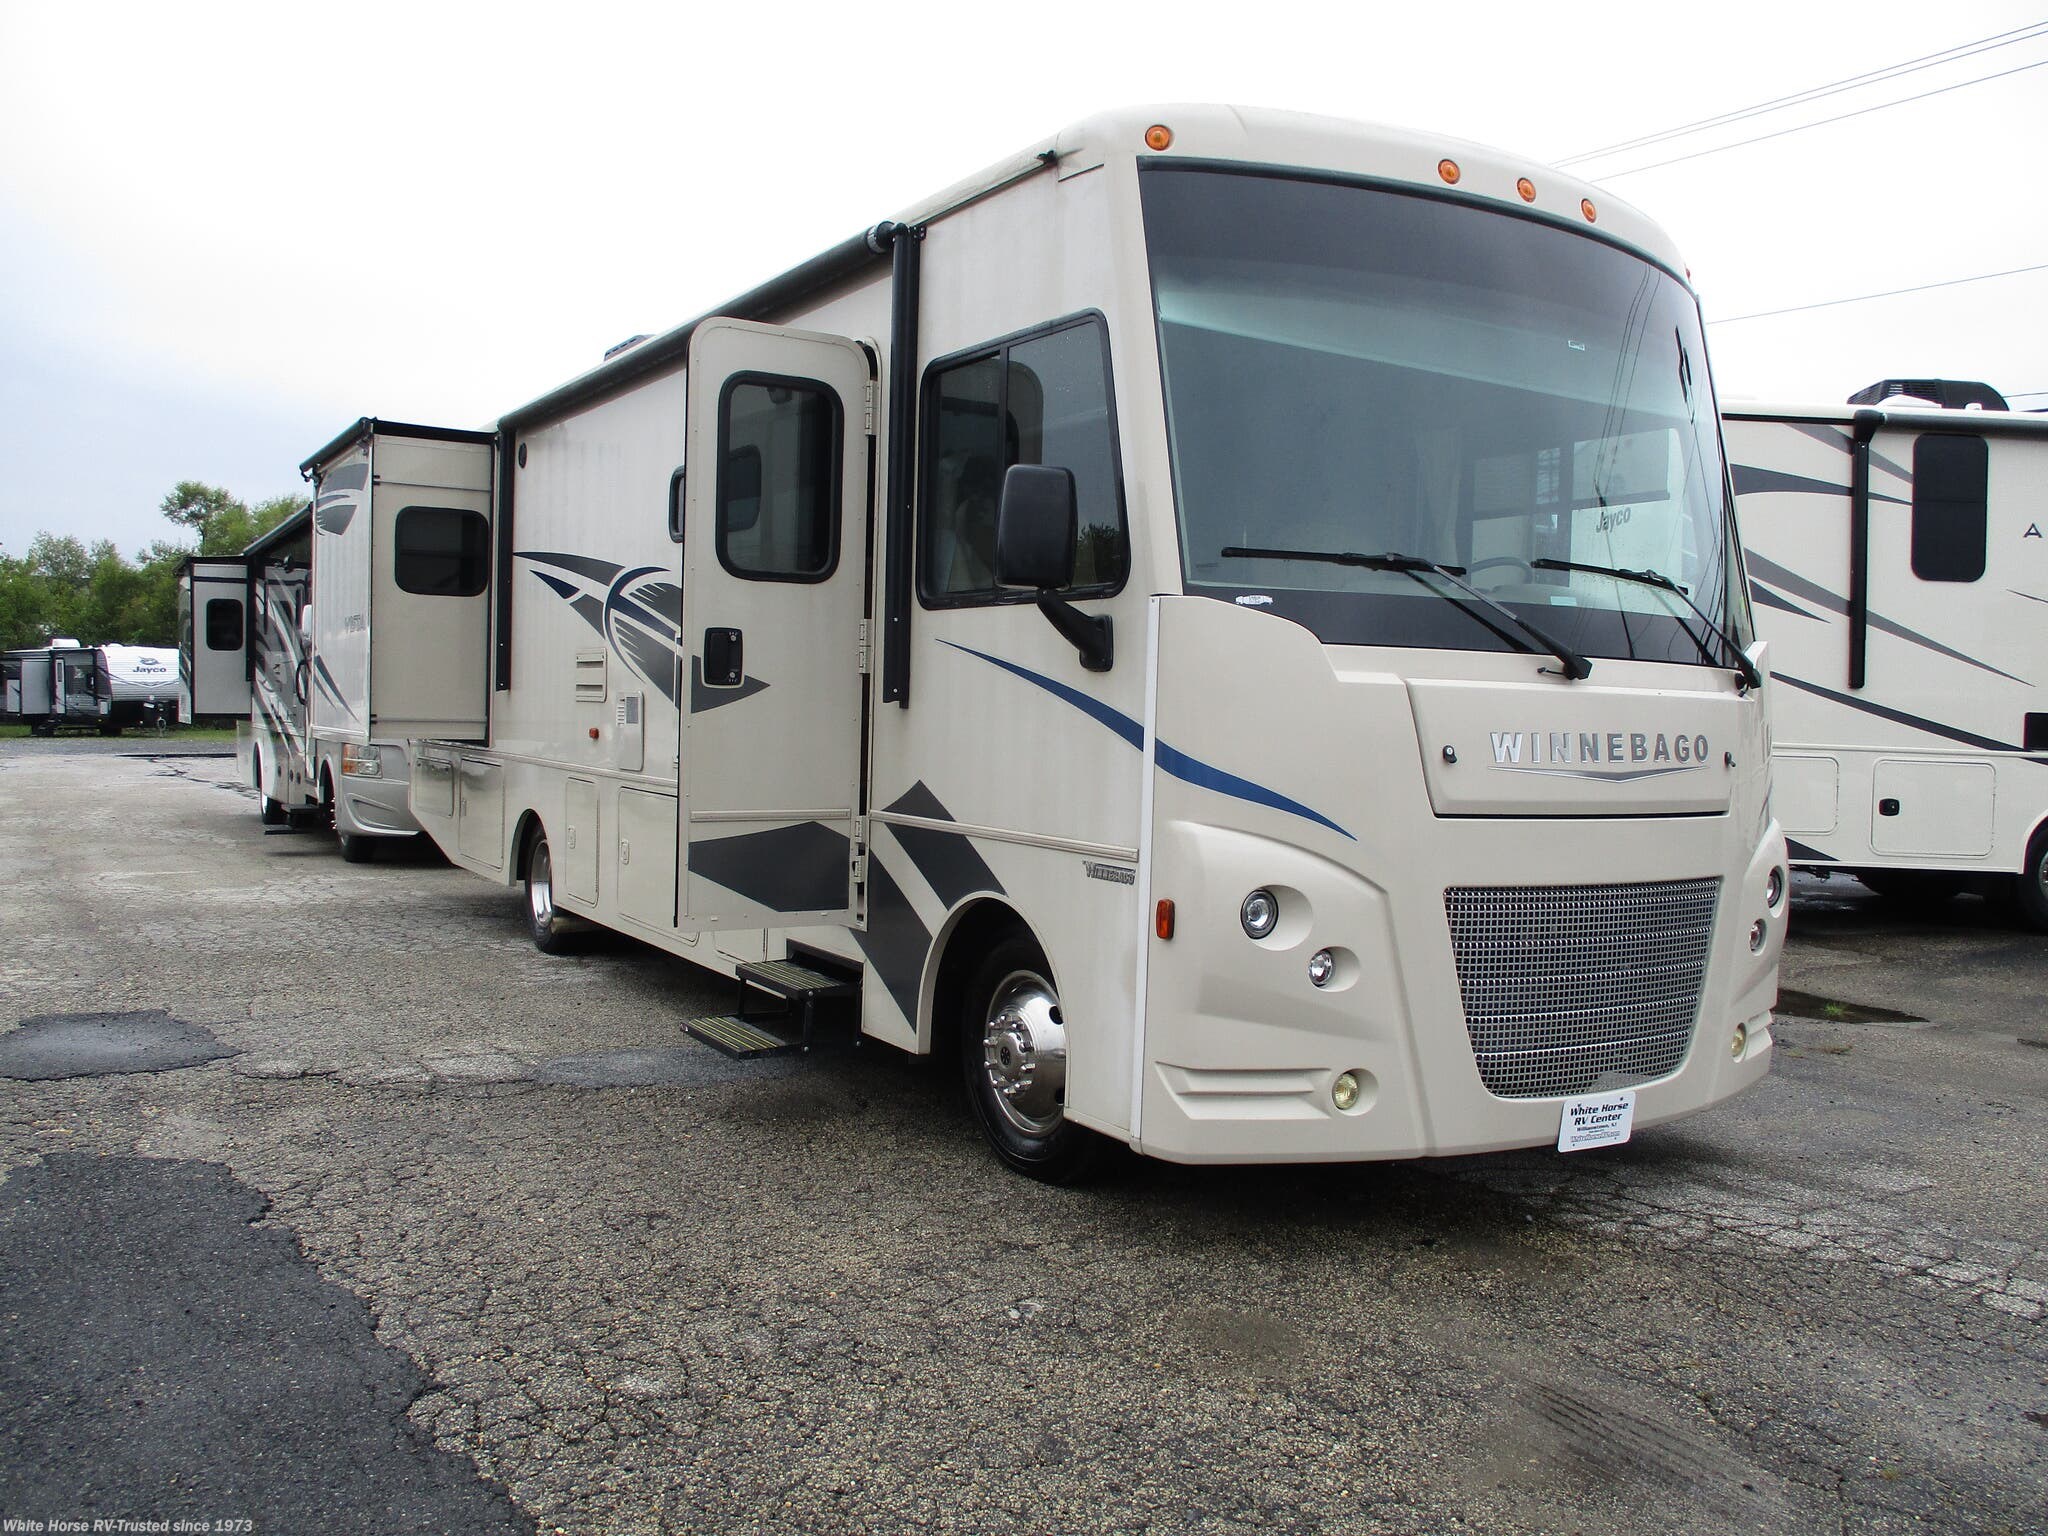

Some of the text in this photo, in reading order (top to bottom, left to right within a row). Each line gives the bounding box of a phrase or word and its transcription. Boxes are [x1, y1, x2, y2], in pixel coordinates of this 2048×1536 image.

[1596, 507, 1631, 533] Jayco
[133, 666, 167, 674] Jayco
[1490, 731, 1709, 764] WINNEBAGO
[1570, 1102, 1628, 1116] White Horse
[1574, 1113, 1622, 1126] RV Center
